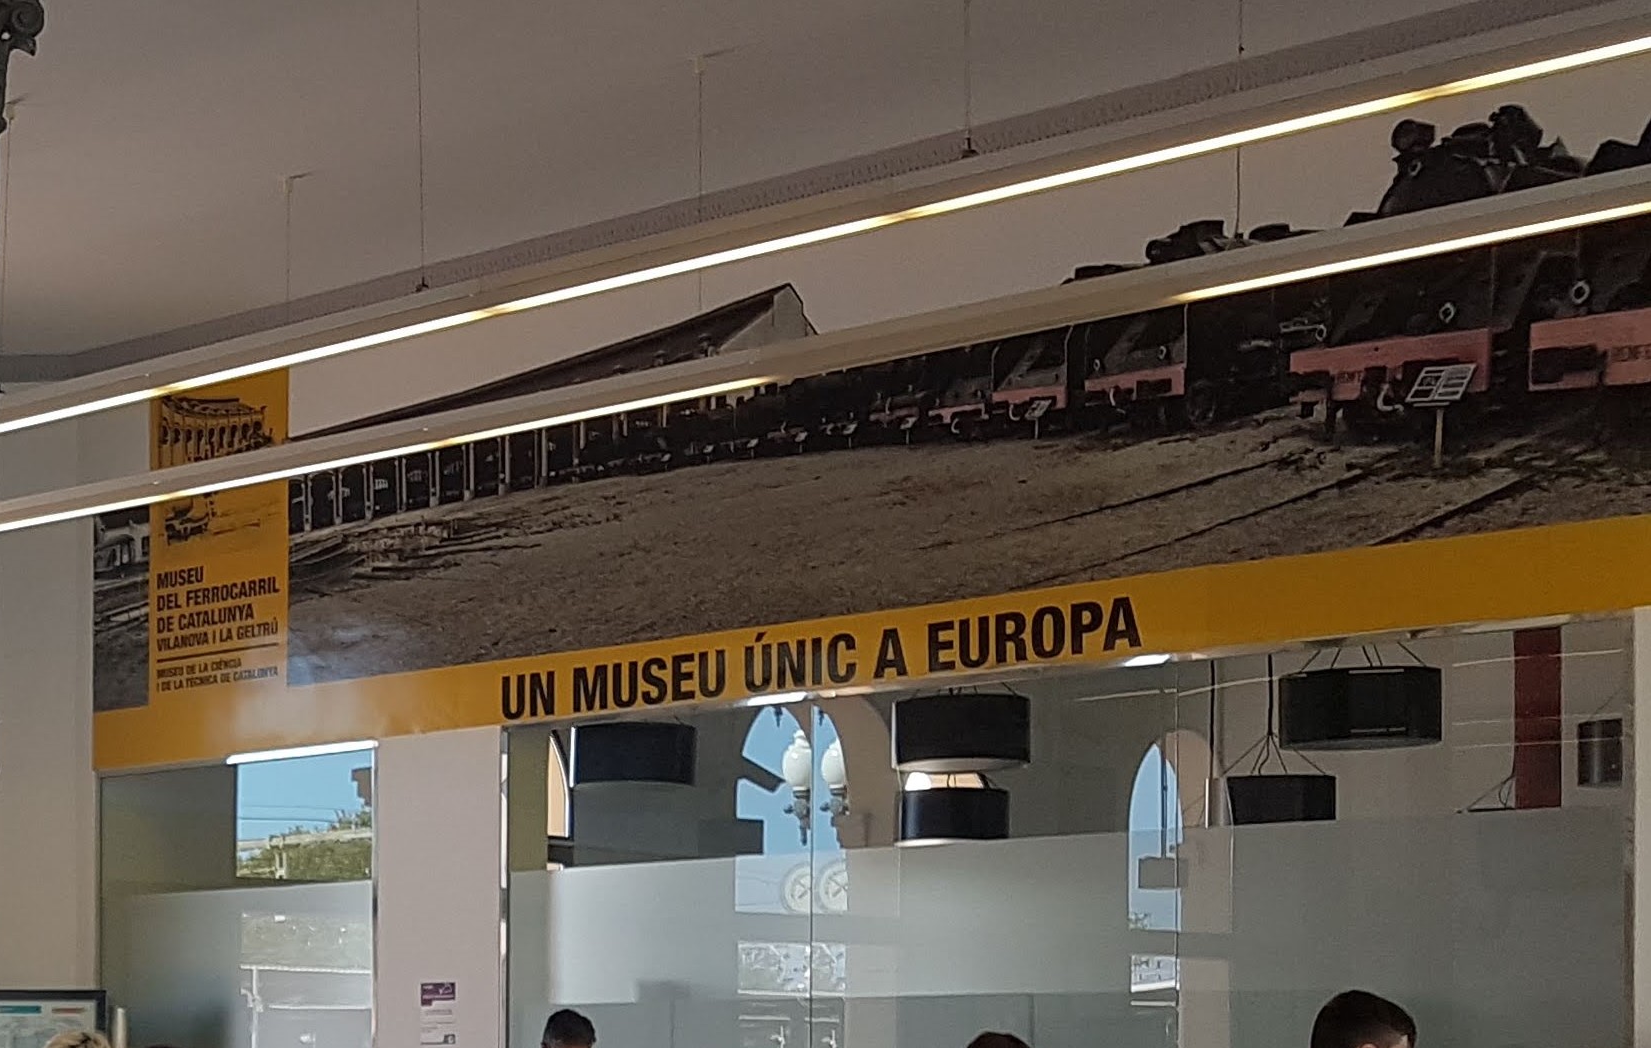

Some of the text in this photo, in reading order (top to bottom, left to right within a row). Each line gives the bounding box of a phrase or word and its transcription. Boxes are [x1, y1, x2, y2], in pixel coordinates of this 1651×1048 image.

[156, 565, 204, 590] MUSEU
[156, 576, 280, 612] DEL FERROCARRIL
[156, 603, 255, 634] DE CATALUNYA
[156, 616, 279, 652] VILANOVA I LA GELTRÚ
[186, 663, 197, 675] DE
[198, 660, 208, 674] LA
[501, 596, 1143, 721] UN MUSEU ÚNIC A EUROPA
[161, 677, 172, 692] DE
[173, 678, 184, 690] LA
